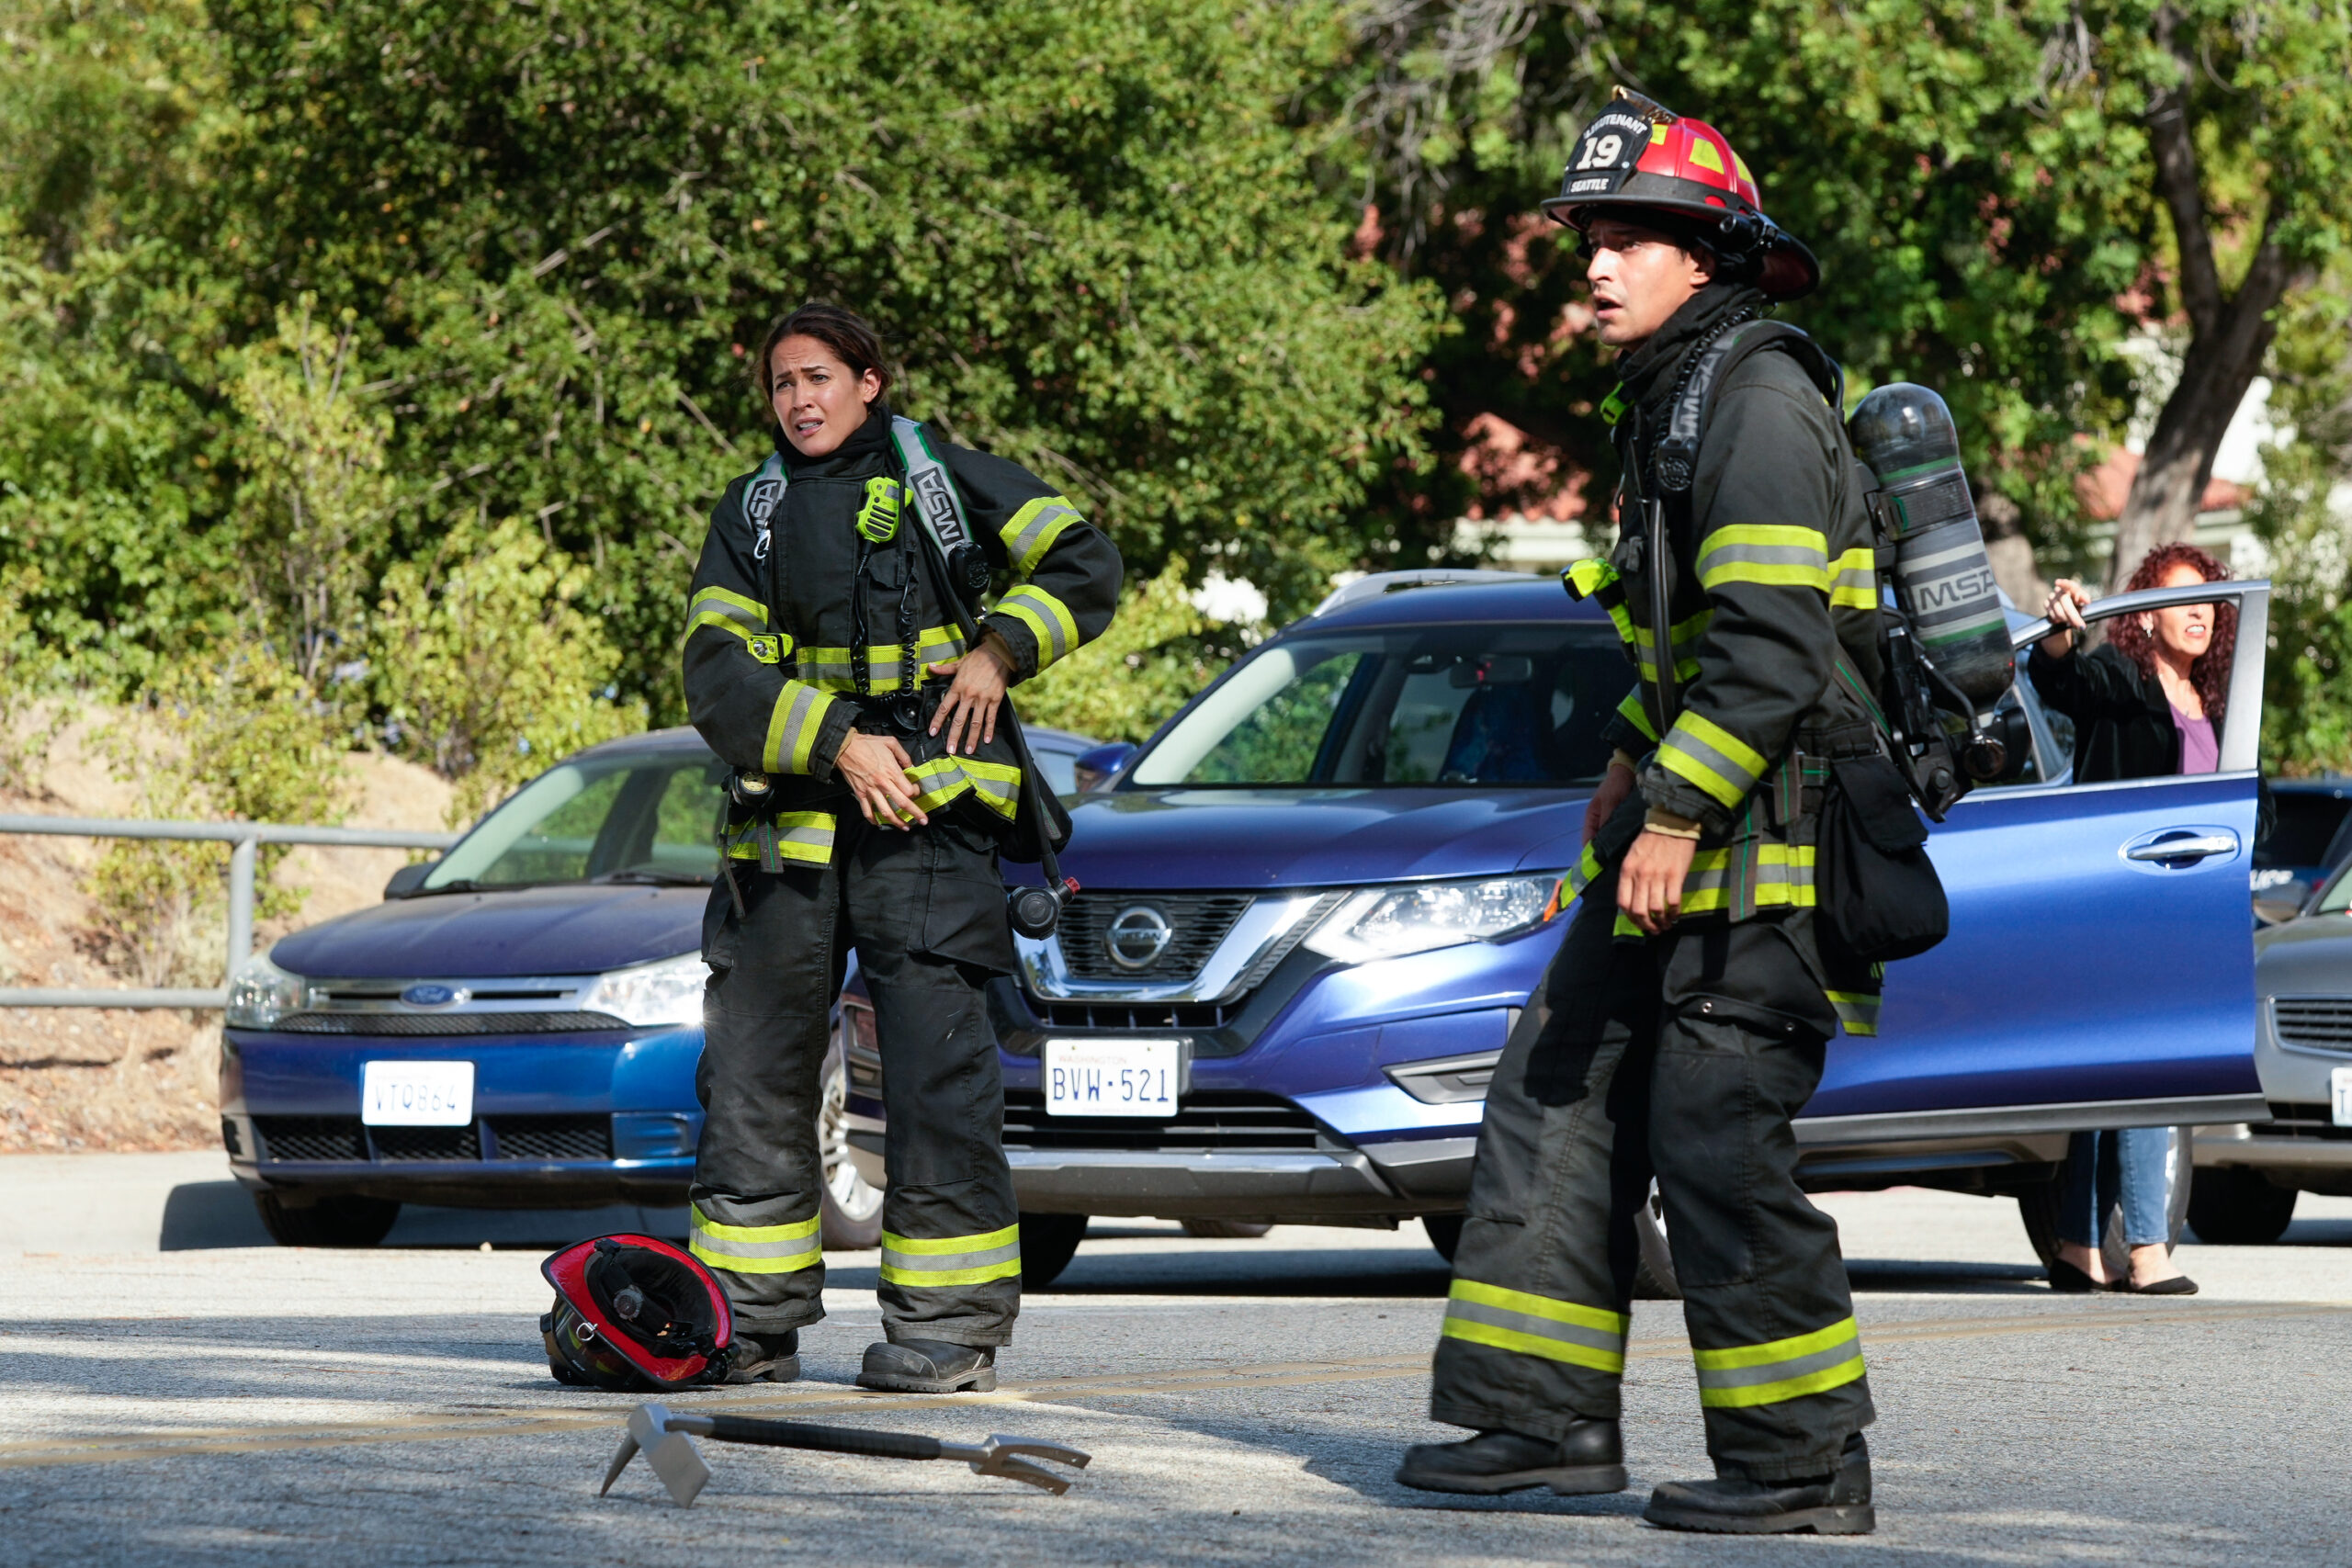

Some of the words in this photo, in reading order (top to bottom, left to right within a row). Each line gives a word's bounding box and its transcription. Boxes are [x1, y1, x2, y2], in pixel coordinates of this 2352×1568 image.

[1583, 113, 1647, 140] LIEUTENANT
[1576, 134, 1623, 170] 19
[1570, 177, 1610, 193] SEATTLE
[917, 470, 961, 540] MSA
[1919, 569, 1995, 611] MSA
